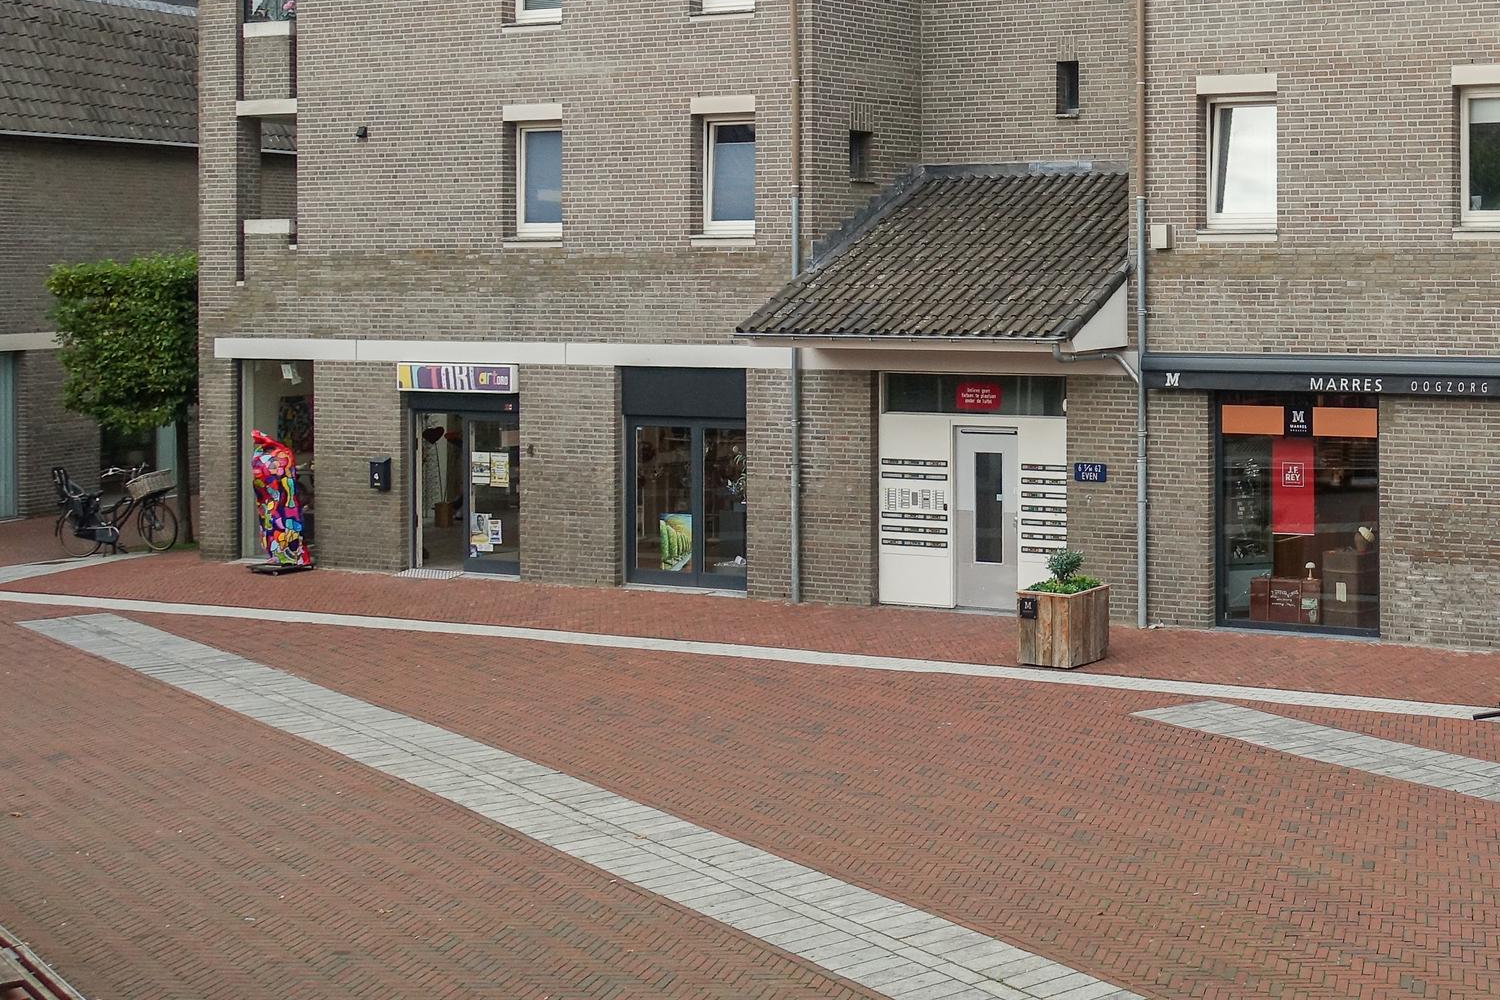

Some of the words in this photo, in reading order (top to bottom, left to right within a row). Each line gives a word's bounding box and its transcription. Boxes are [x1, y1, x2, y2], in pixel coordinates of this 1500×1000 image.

[1165, 372, 1180, 387] M
[1310, 378, 1382, 392] MARRES
[1410, 381, 1488, 393] OOGZORG
[1292, 411, 1304, 423] M
[1082, 472, 1098, 480] EVEN
